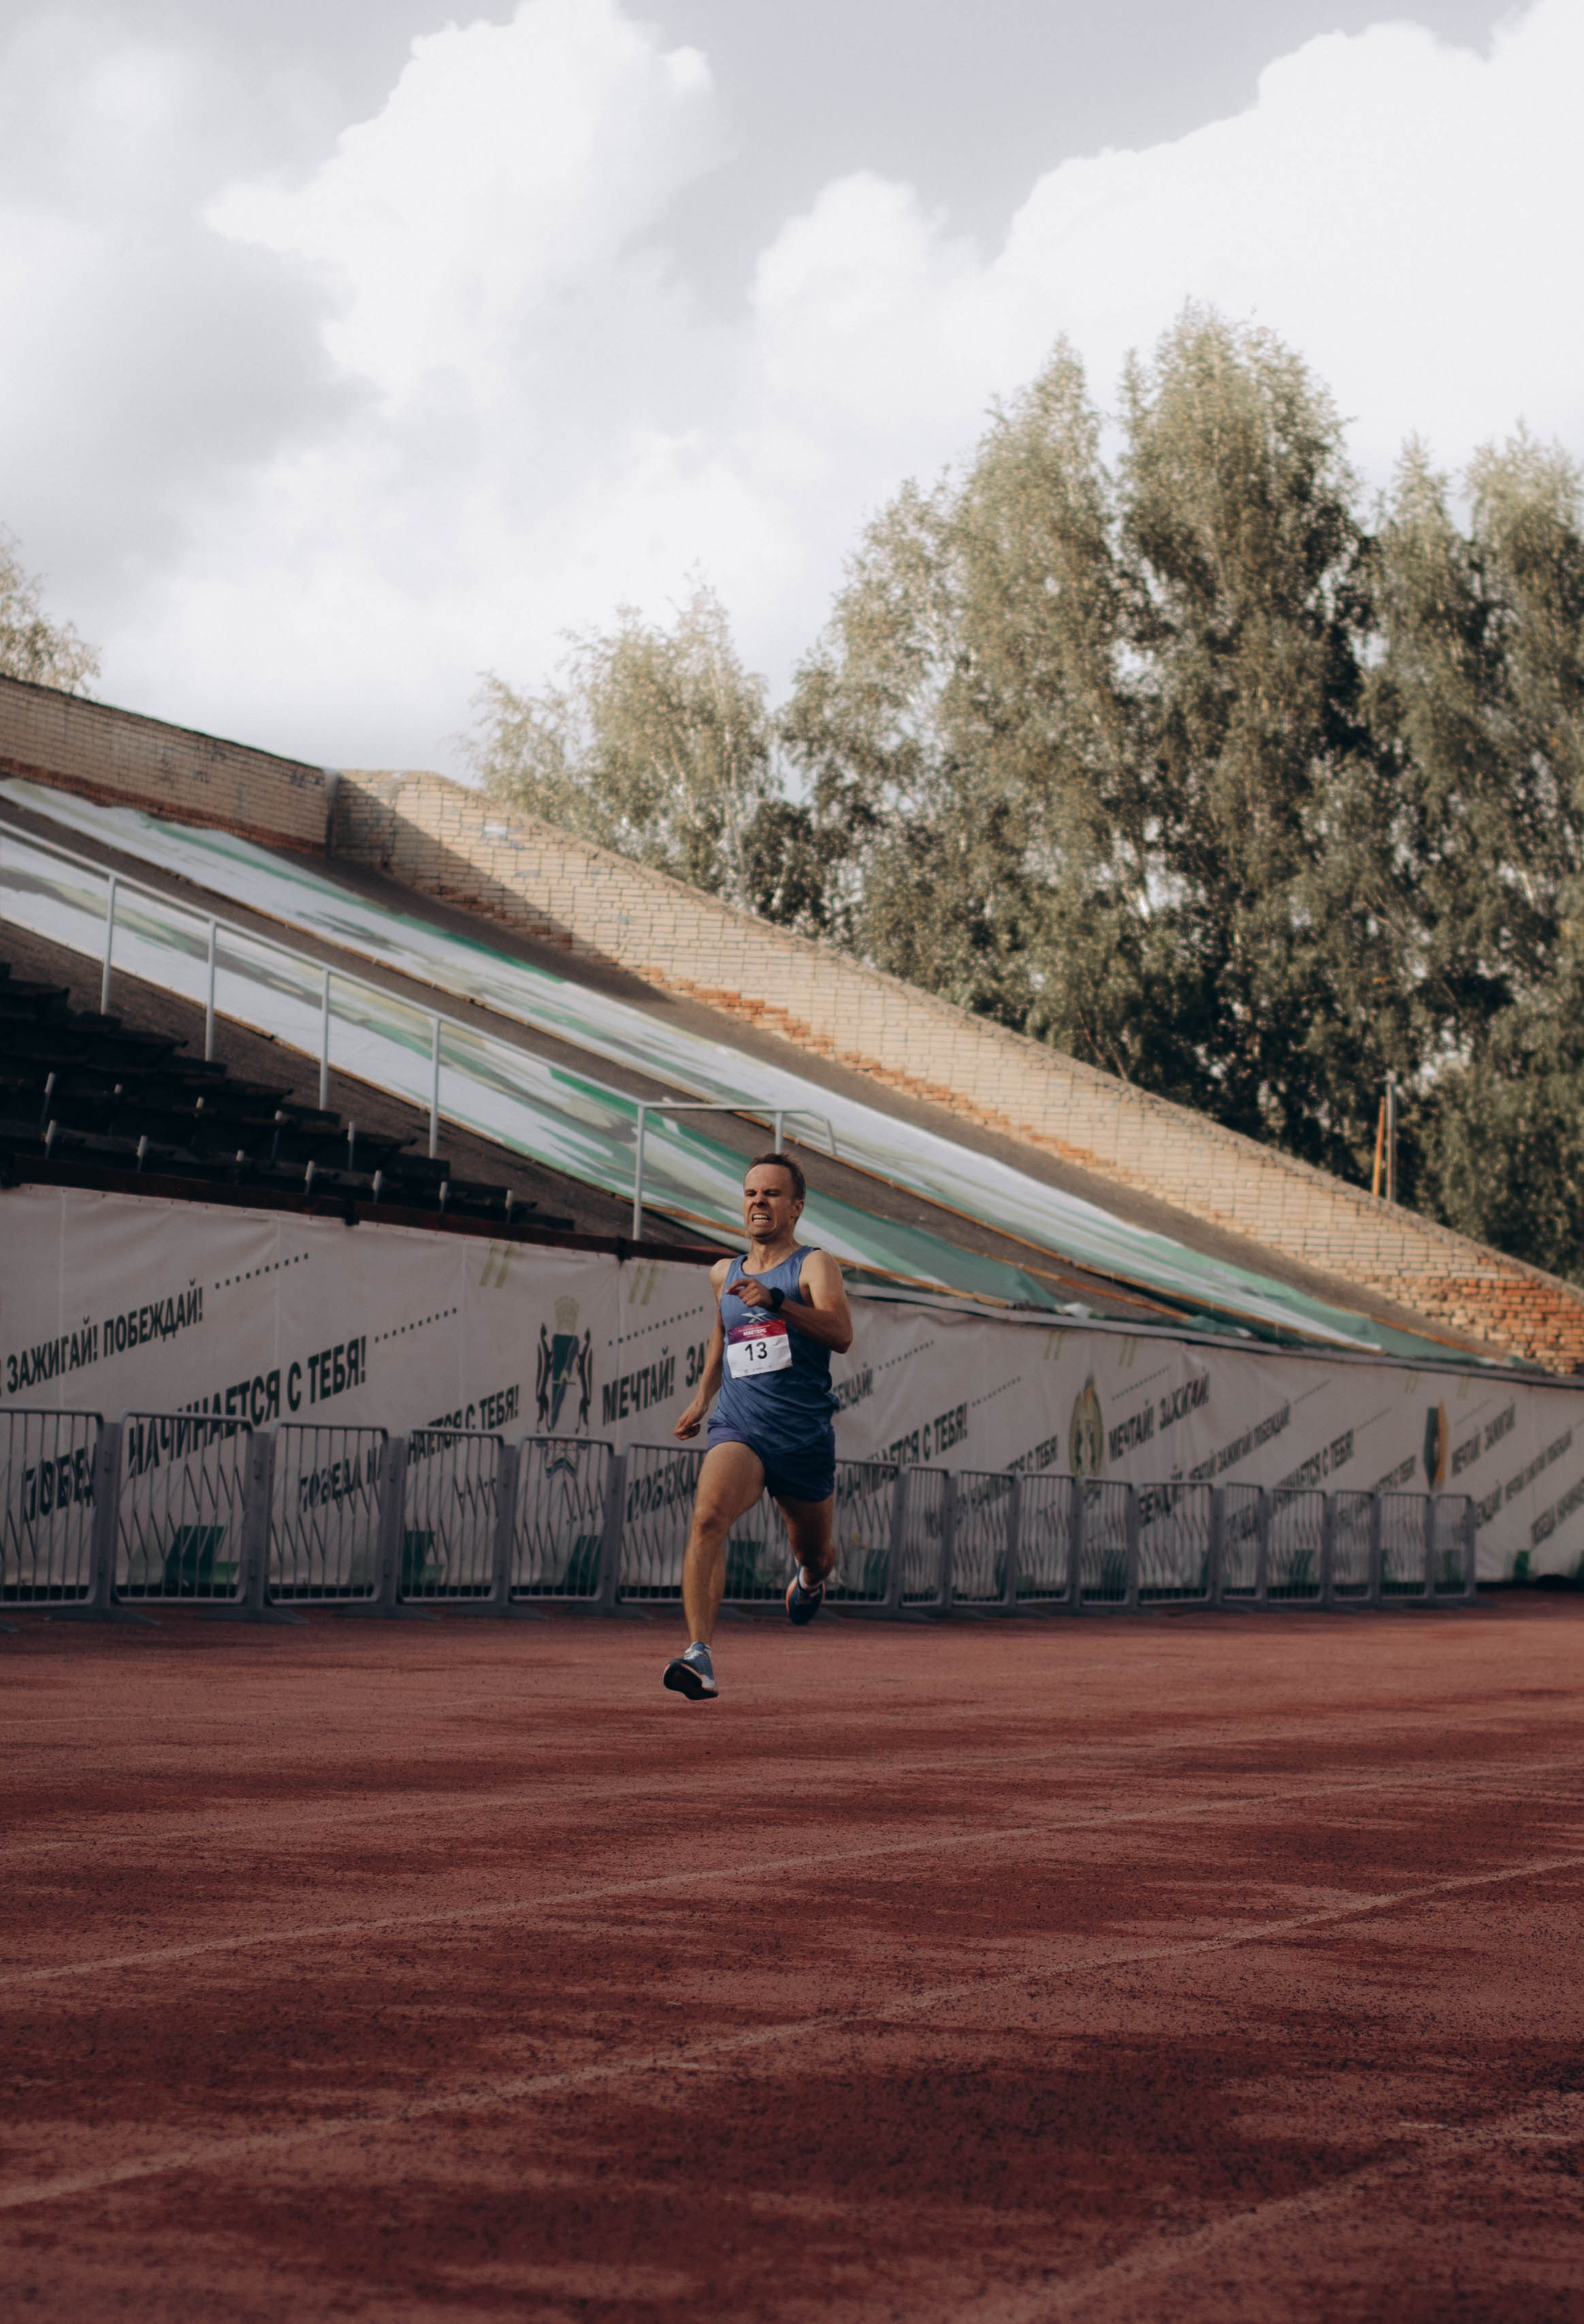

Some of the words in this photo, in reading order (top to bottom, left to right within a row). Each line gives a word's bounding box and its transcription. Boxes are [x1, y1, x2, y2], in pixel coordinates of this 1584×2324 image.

[7, 1314, 98, 1394] ЗАЖИГАЙ!
[103, 1277, 203, 1358] ПОБЕЖДАЙ!
[745, 1341, 768, 1362] 13
[287, 1361, 302, 1412] С
[308, 1335, 367, 1405] ТЕБЯ!
[479, 1384, 520, 1430] ТЕБЯ!
[603, 1345, 676, 1426] МЕЧТАЙ!
[922, 1422, 933, 1462] С
[934, 1403, 968, 1456] ТЕБЯ!
